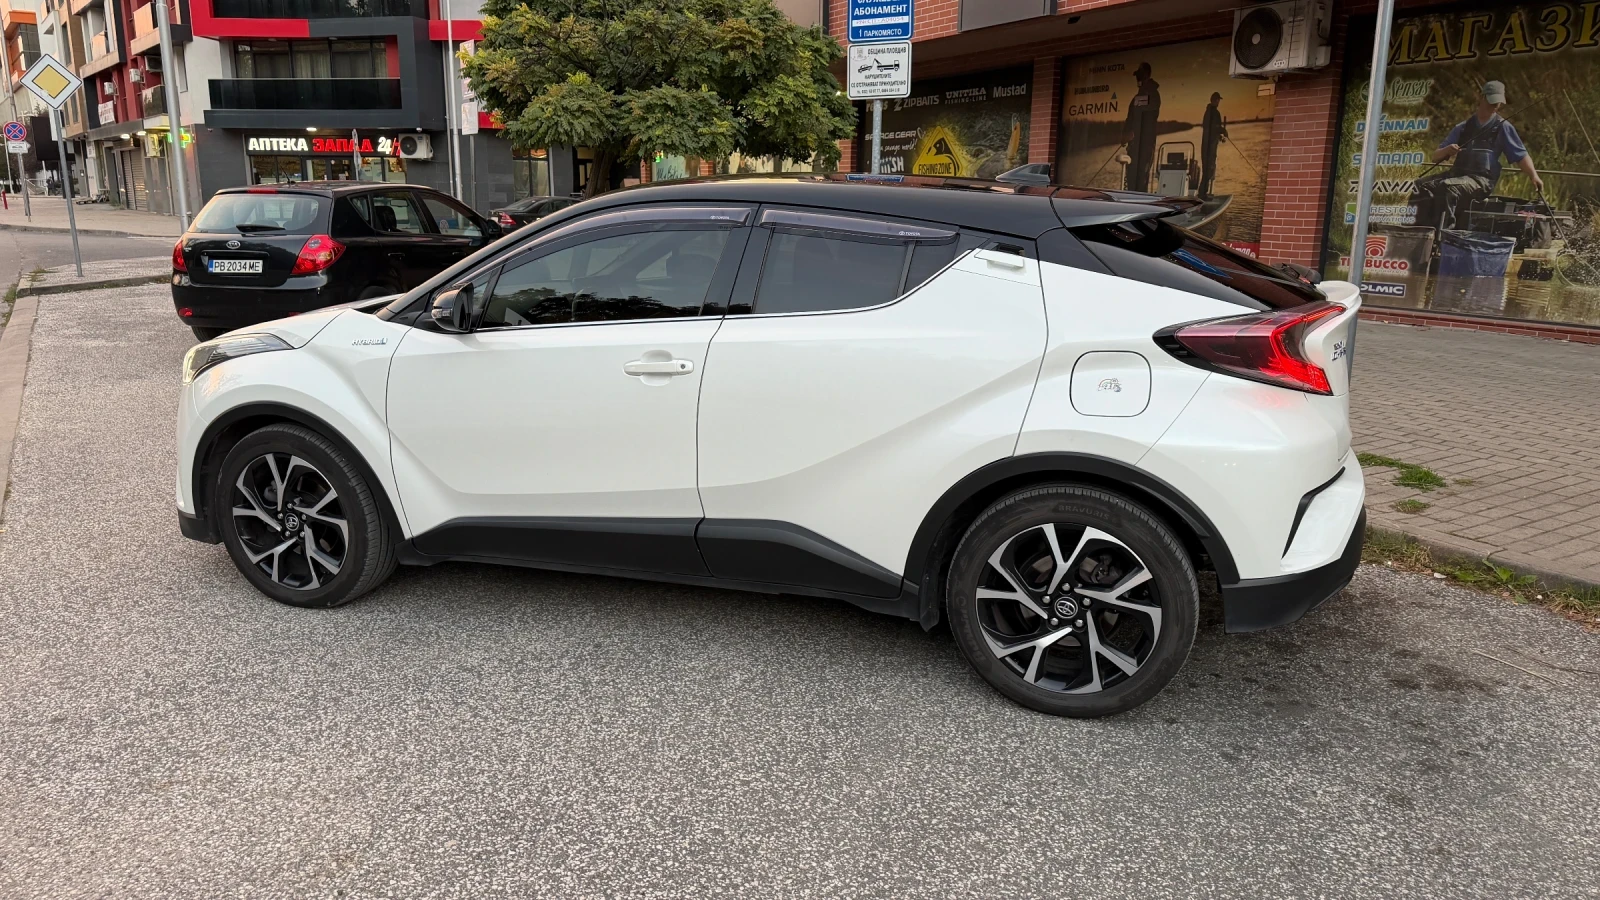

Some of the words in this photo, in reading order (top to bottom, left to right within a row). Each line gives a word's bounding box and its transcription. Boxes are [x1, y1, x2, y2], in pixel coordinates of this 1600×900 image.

[854, 5, 907, 16] АБОНАМЕНТ
[858, 29, 862, 37] 1
[864, 29, 902, 37] ПАРКОМЯСТО
[886, 46, 907, 54] ПЛОВДИВ
[1107, 64, 1125, 72] KOTA
[945, 87, 987, 99] UNITIKA
[993, 83, 1027, 98] Mustad
[1388, 78, 1432, 99] Sensas
[1068, 101, 1119, 116] GARMIN
[1356, 119, 1429, 132] DNNAN
[895, 130, 917, 138] GEAR
[249, 138, 308, 151] АПТЕКА
[313, 139, 373, 152] ЗАПАД
[1352, 152, 1424, 165] SMANO
[1370, 206, 1417, 215] RESTON
[1369, 216, 1416, 224] NOVATIONS
[214, 262, 226, 272] PB
[227, 261, 247, 272] 2034
[248, 261, 260, 272] ME
[1340, 257, 1409, 270] TBUCCO
[1361, 284, 1403, 294] OLMIC
[1058, 504, 1110, 520] BRAVURIS
